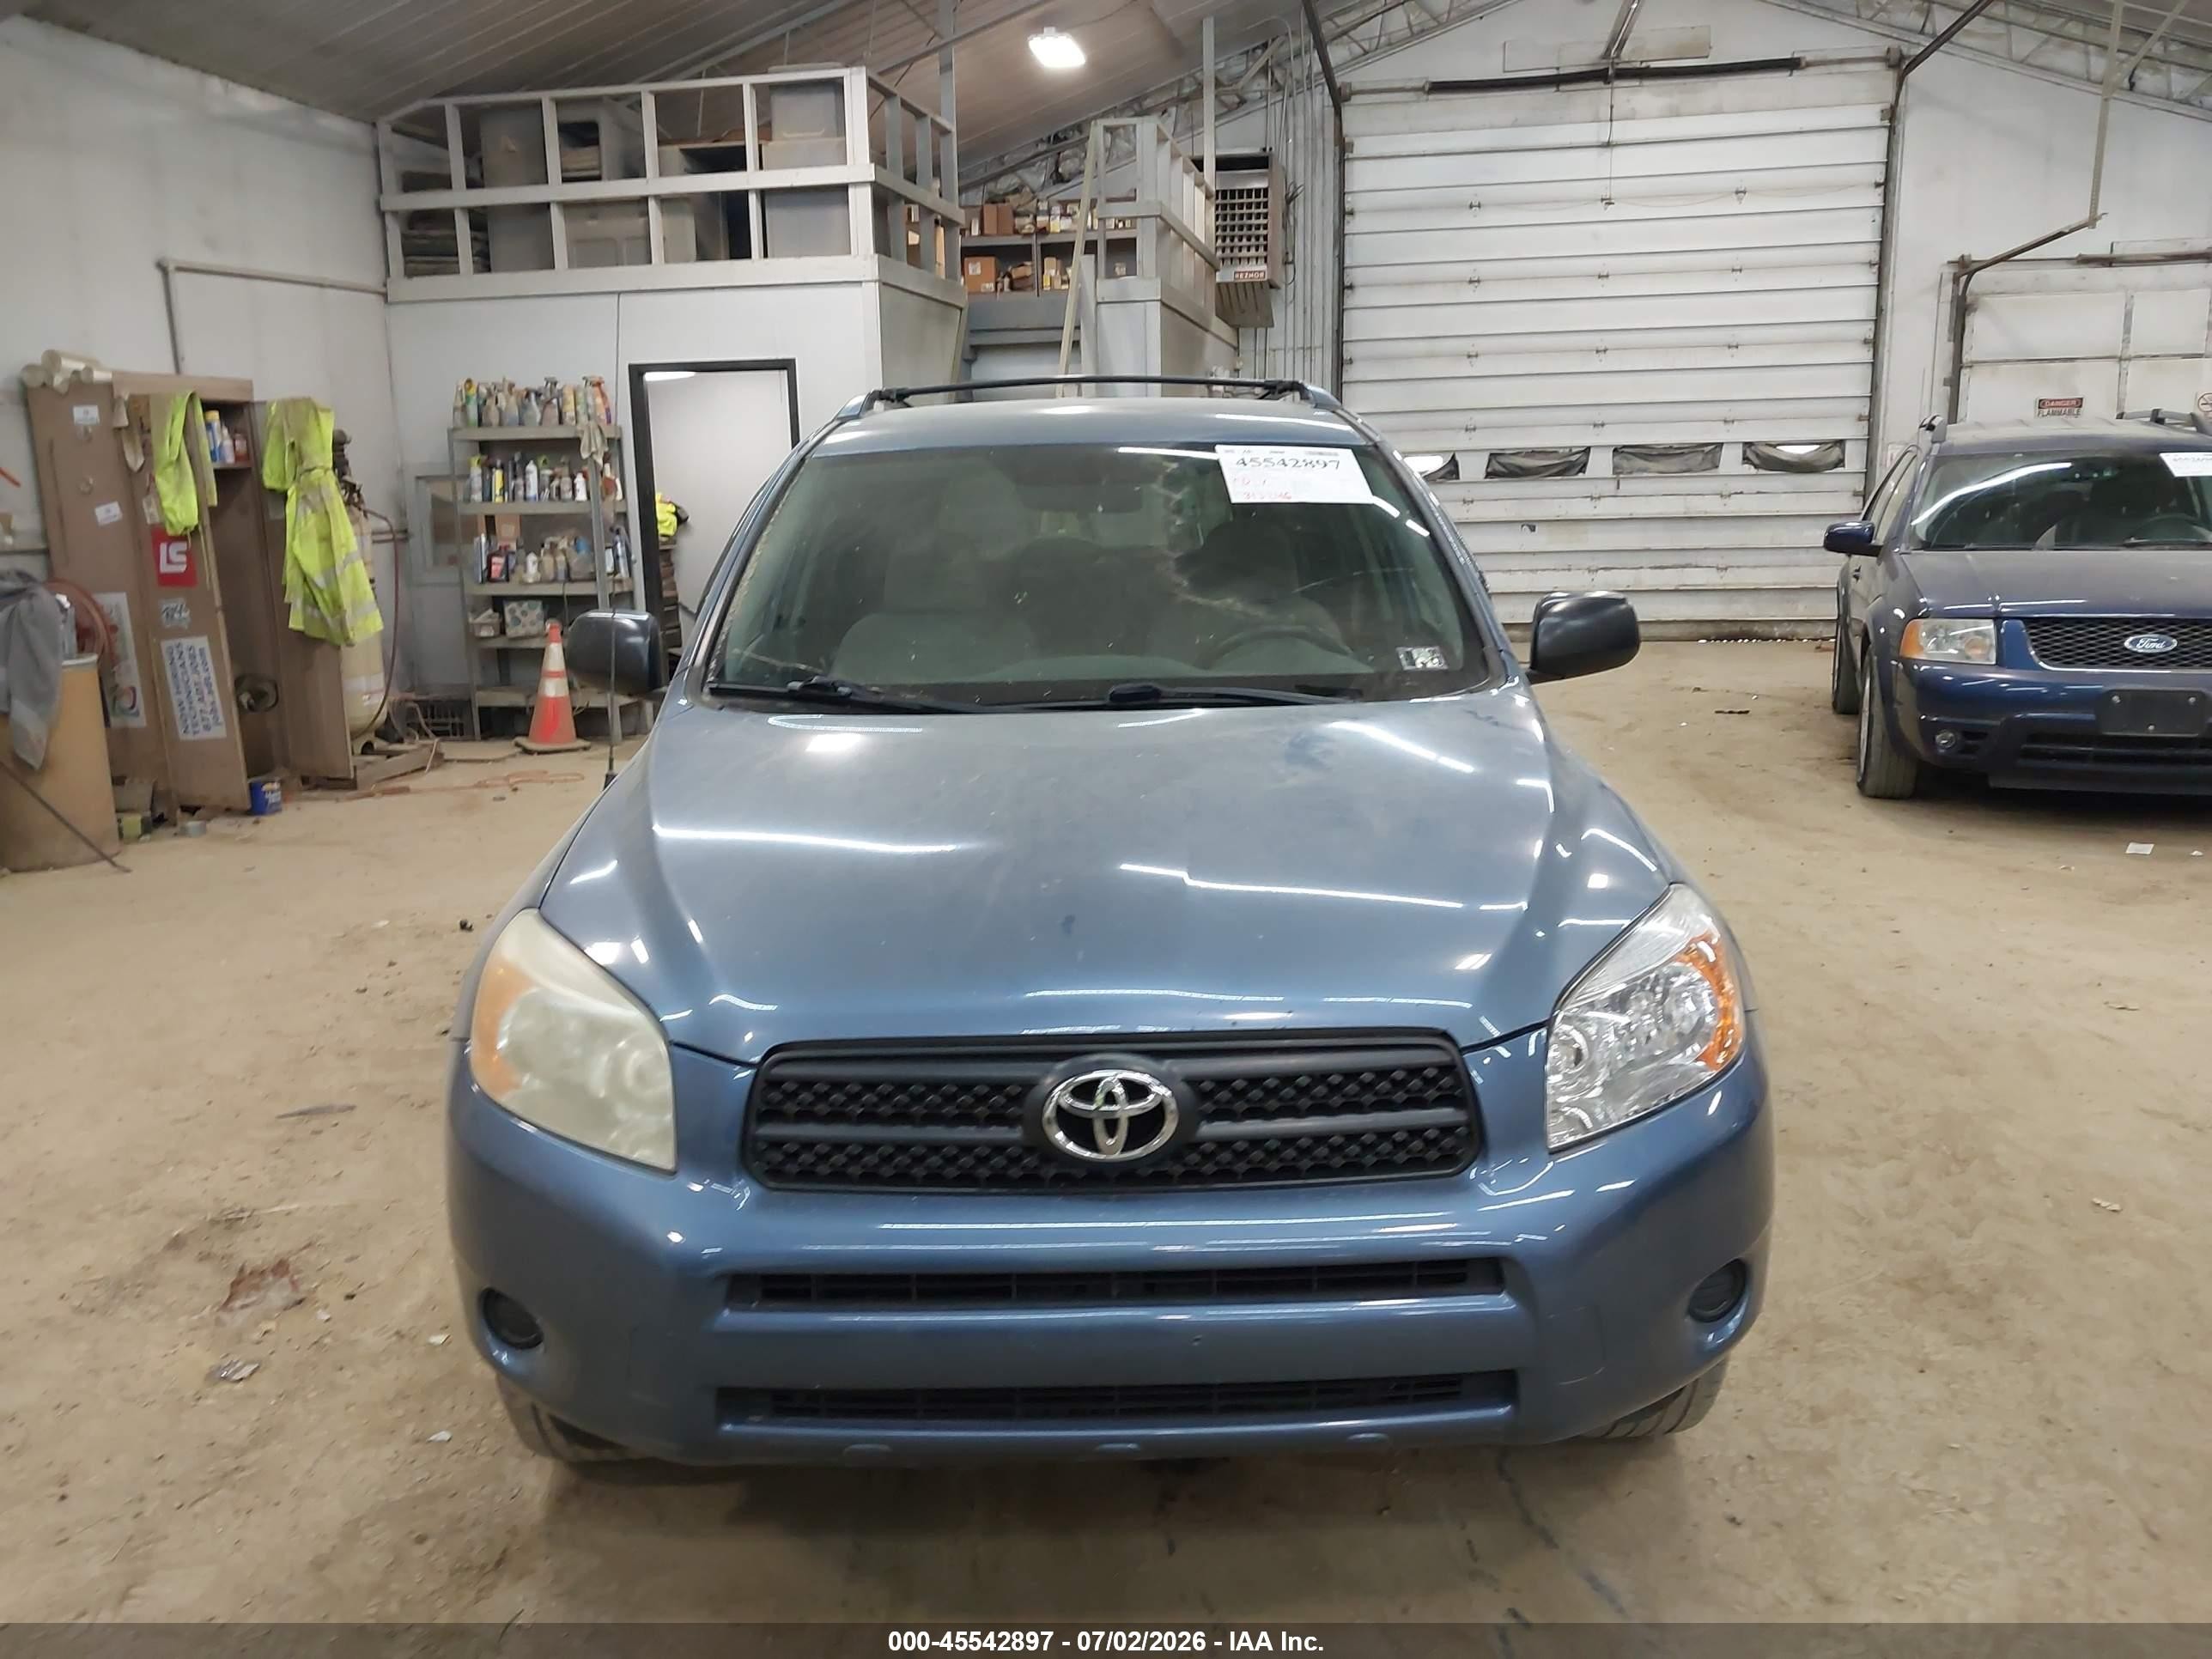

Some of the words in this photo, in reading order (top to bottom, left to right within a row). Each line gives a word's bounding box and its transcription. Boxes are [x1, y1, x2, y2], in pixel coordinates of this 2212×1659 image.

[2038, 408, 2081, 417] FLAMMABLE
[1236, 457, 1340, 469] 45542897
[2136, 638, 2166, 648] Ford
[166, 646, 181, 695] HIRING
[175, 642, 198, 735] TECHNICIANS
[178, 699, 189, 734] NOW
